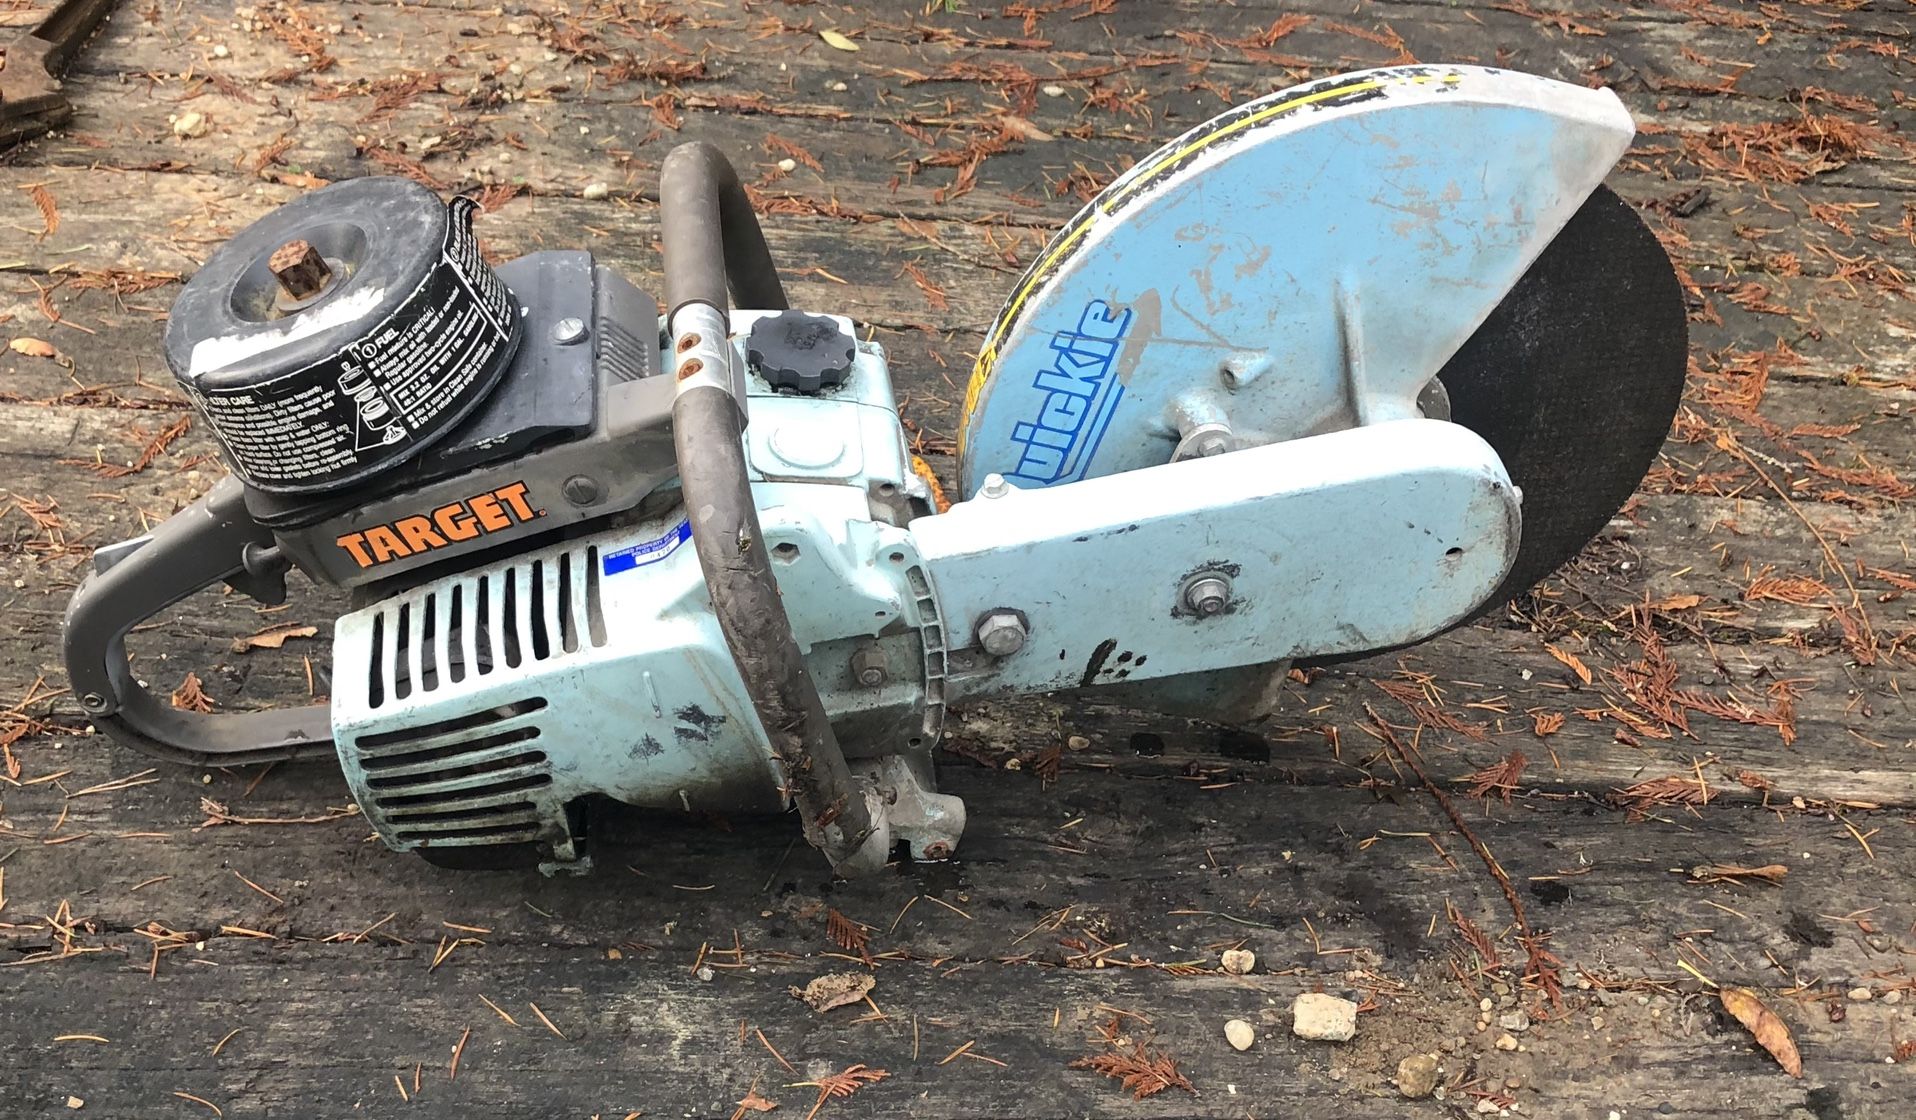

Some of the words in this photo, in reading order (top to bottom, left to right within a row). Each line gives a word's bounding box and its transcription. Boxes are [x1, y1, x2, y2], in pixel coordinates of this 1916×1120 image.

[375, 328, 400, 349] FUEL
[380, 356, 399, 373] Always
[399, 347, 409, 358] mix
[415, 331, 426, 343] with
[425, 316, 440, 333] leaded
[438, 310, 444, 319] or
[375, 352, 388, 364] Fuel
[388, 336, 408, 356] mixture
[390, 376, 403, 386] Use
[402, 355, 426, 378] approved
[424, 333, 447, 357] two-cycle
[445, 317, 459, 335] engine
[384, 360, 407, 379] Regular
[398, 388, 410, 400] MIX
[410, 381, 420, 391] 3.2
[430, 364, 440, 374] OIL
[439, 351, 452, 366] WITH
[304, 396, 322, 408] cause
[322, 389, 336, 401] poor
[413, 407, 426, 418] Mix
[424, 402, 431, 410] &
[430, 392, 445, 405] store
[448, 374, 463, 389] Clean
[461, 364, 472, 376] Safe
[415, 382, 432, 397] RATIO
[418, 415, 428, 425] Do
[428, 408, 438, 419] not
[437, 394, 453, 411] refuel
[451, 383, 465, 398] while
[463, 368, 478, 386] engine
[230, 395, 255, 406] CARE
[259, 402, 276, 411] DAILY
[322, 400, 335, 410] and
[310, 421, 330, 433] ONLY:
[315, 429, 336, 440] bottom
[273, 450, 282, 458] Do
[302, 437, 336, 453] compressed
[310, 466, 332, 474] locking
[330, 462, 342, 470] nut
[340, 456, 357, 466] firmly
[336, 480, 535, 568] TARGET
[636, 539, 663, 551] PROPERTY
